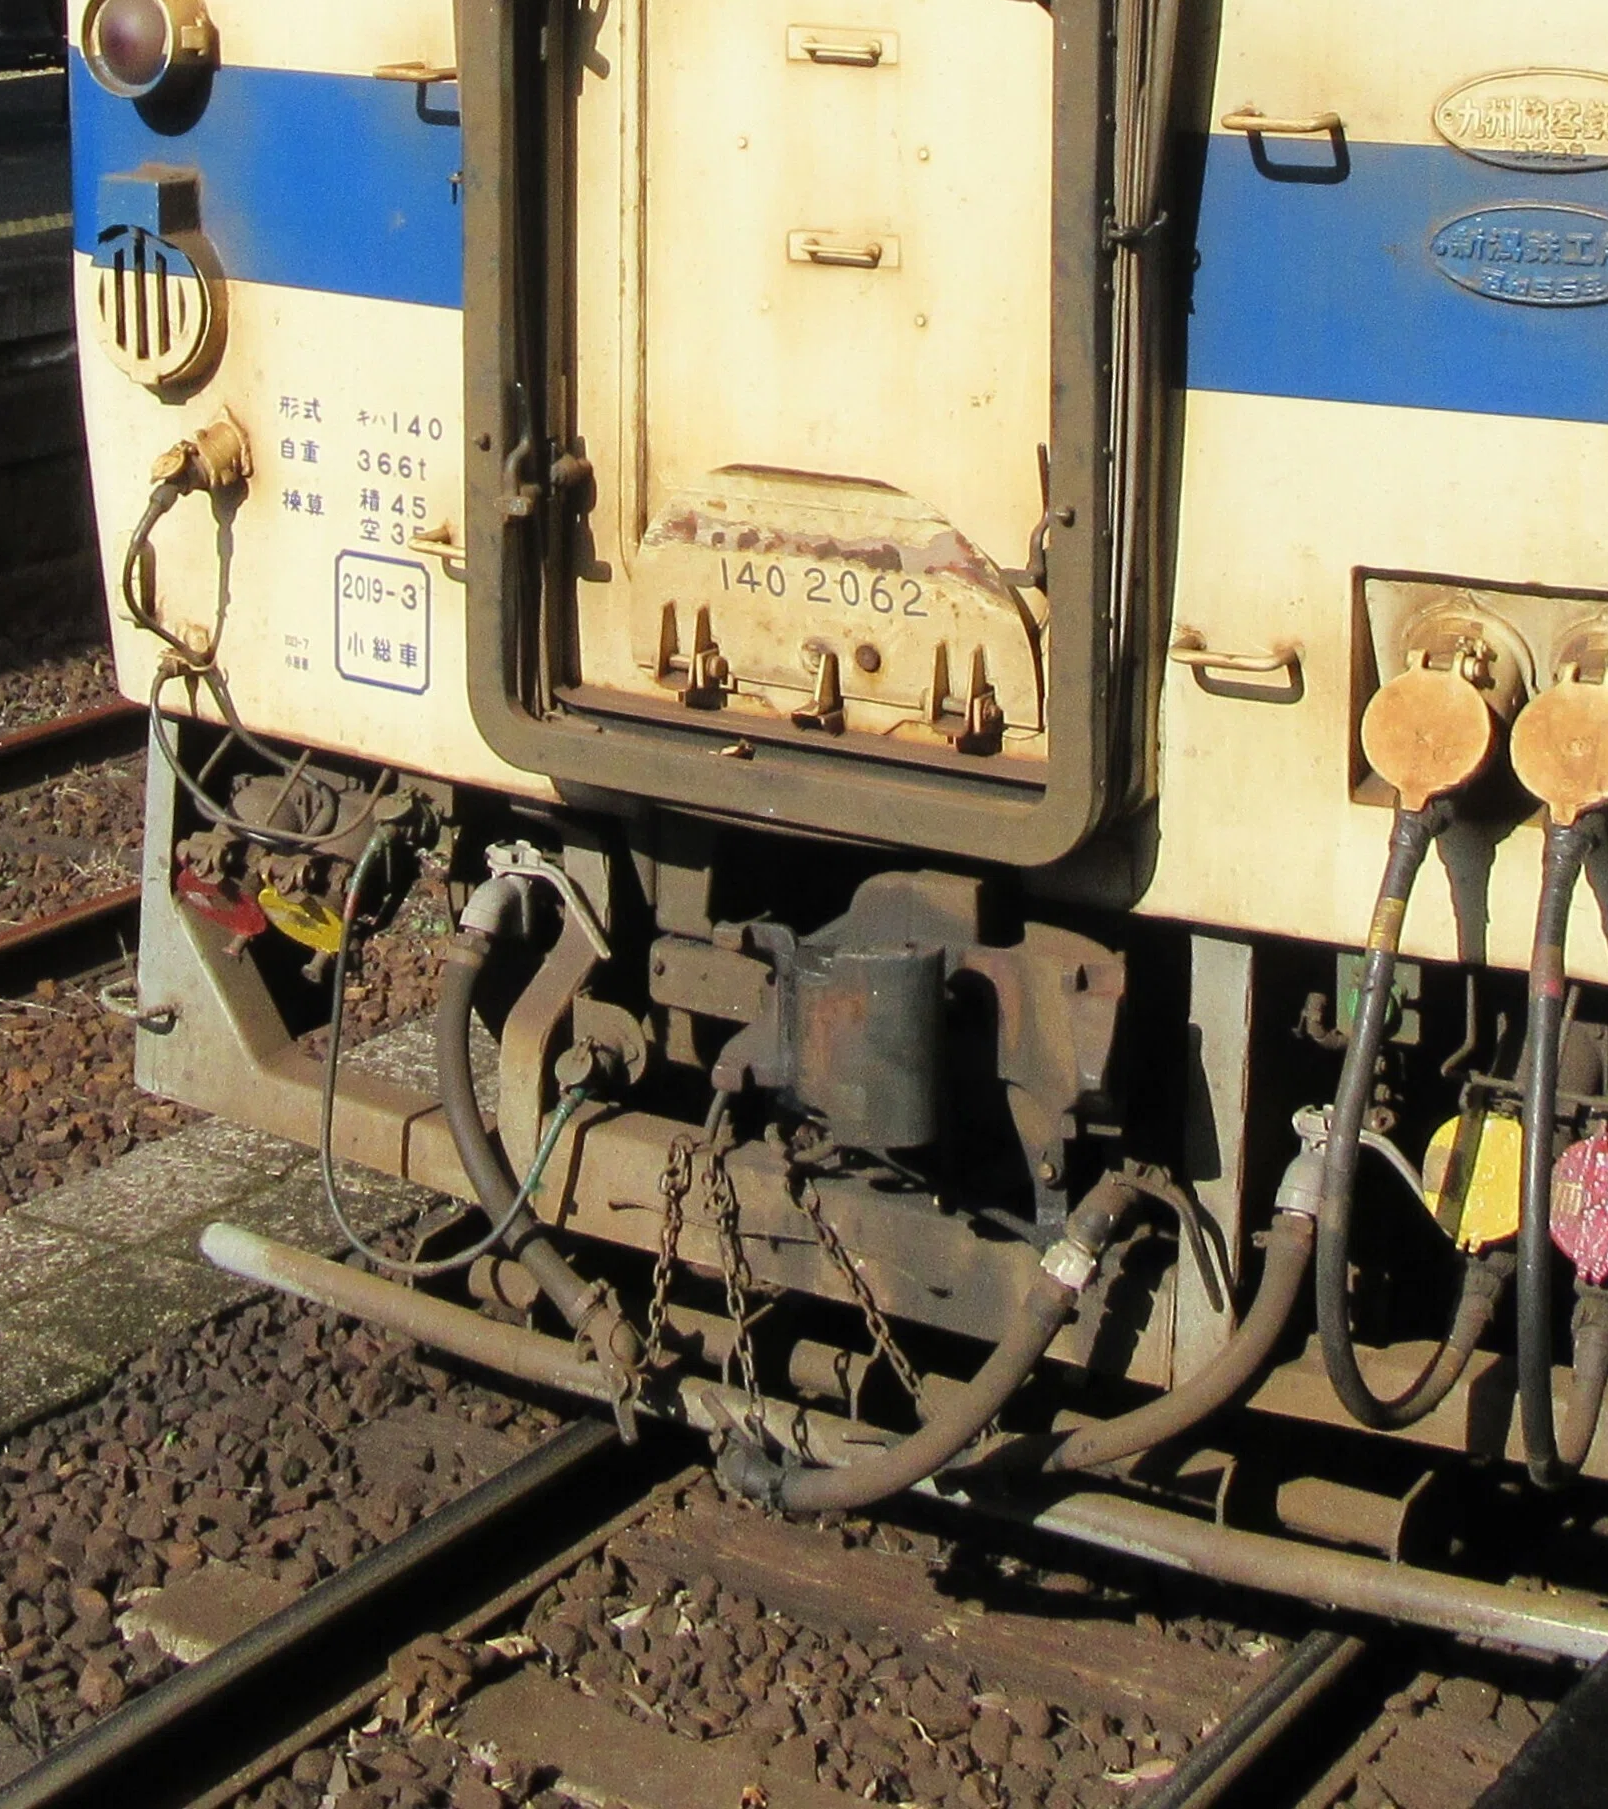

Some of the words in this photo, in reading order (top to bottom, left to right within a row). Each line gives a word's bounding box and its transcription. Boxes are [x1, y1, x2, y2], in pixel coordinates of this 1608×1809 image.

[279, 396, 322, 423] 形式
[280, 437, 320, 464] 自重
[282, 489, 325, 517] 換算
[720, 557, 787, 597] 140
[804, 567, 929, 617] 2062
[347, 631, 418, 669] 小総車
